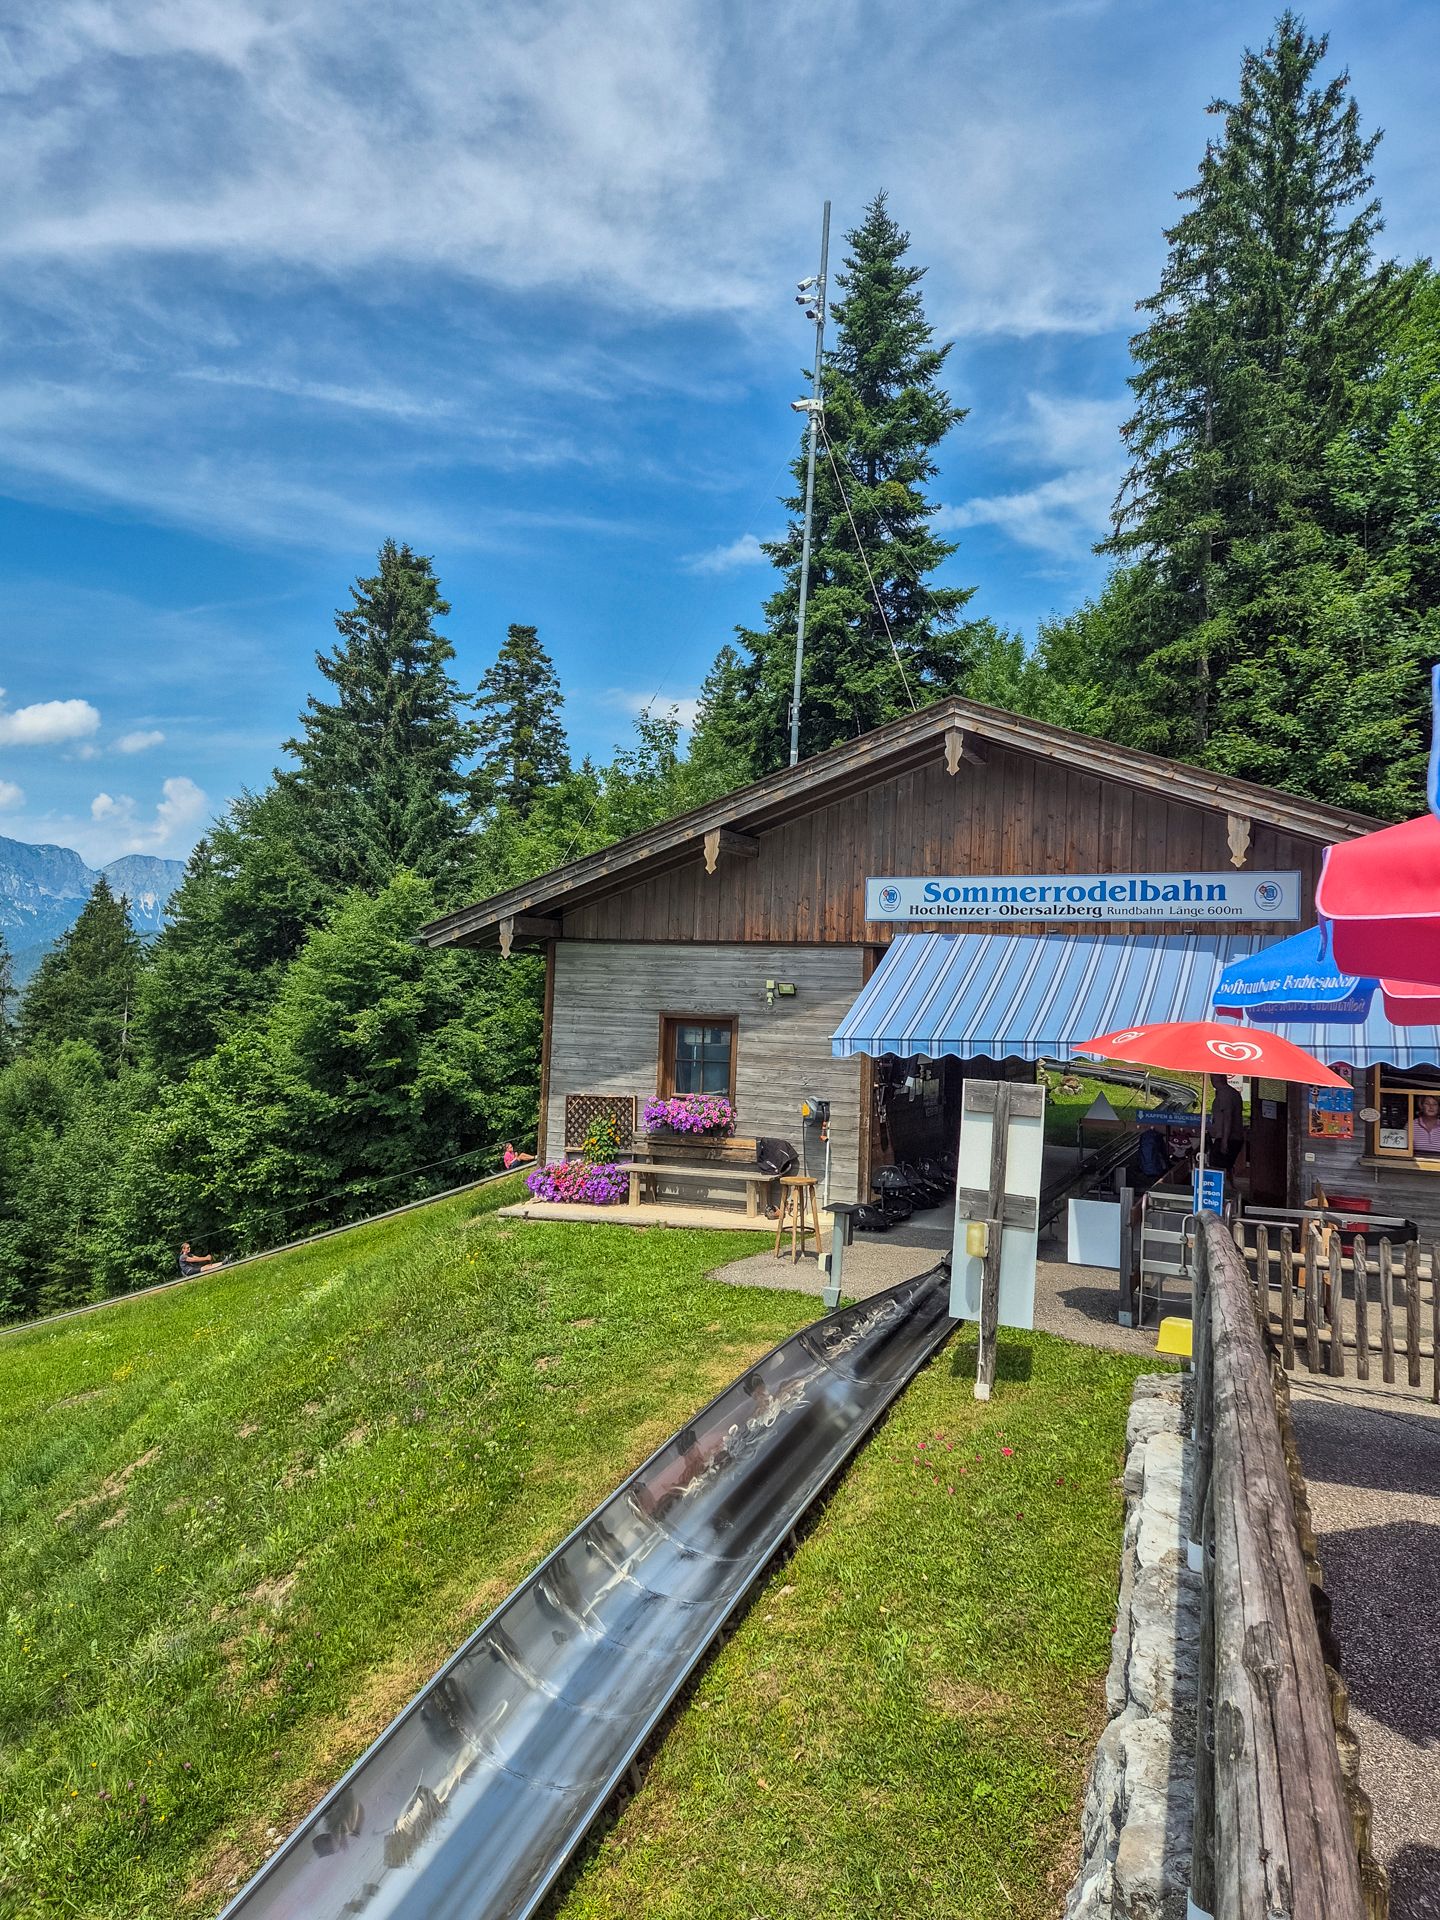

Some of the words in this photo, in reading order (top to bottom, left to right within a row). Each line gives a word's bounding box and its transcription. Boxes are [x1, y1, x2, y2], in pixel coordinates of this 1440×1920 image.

[924, 879, 1227, 903] Sommerrodelbahn
[1107, 906, 1164, 915] Rundbahn
[1169, 906, 1204, 917] Länge
[1207, 906, 1243, 915] 600m
[1203, 1198, 1219, 1207] Chip
[858, 1208, 866, 1219] 8
